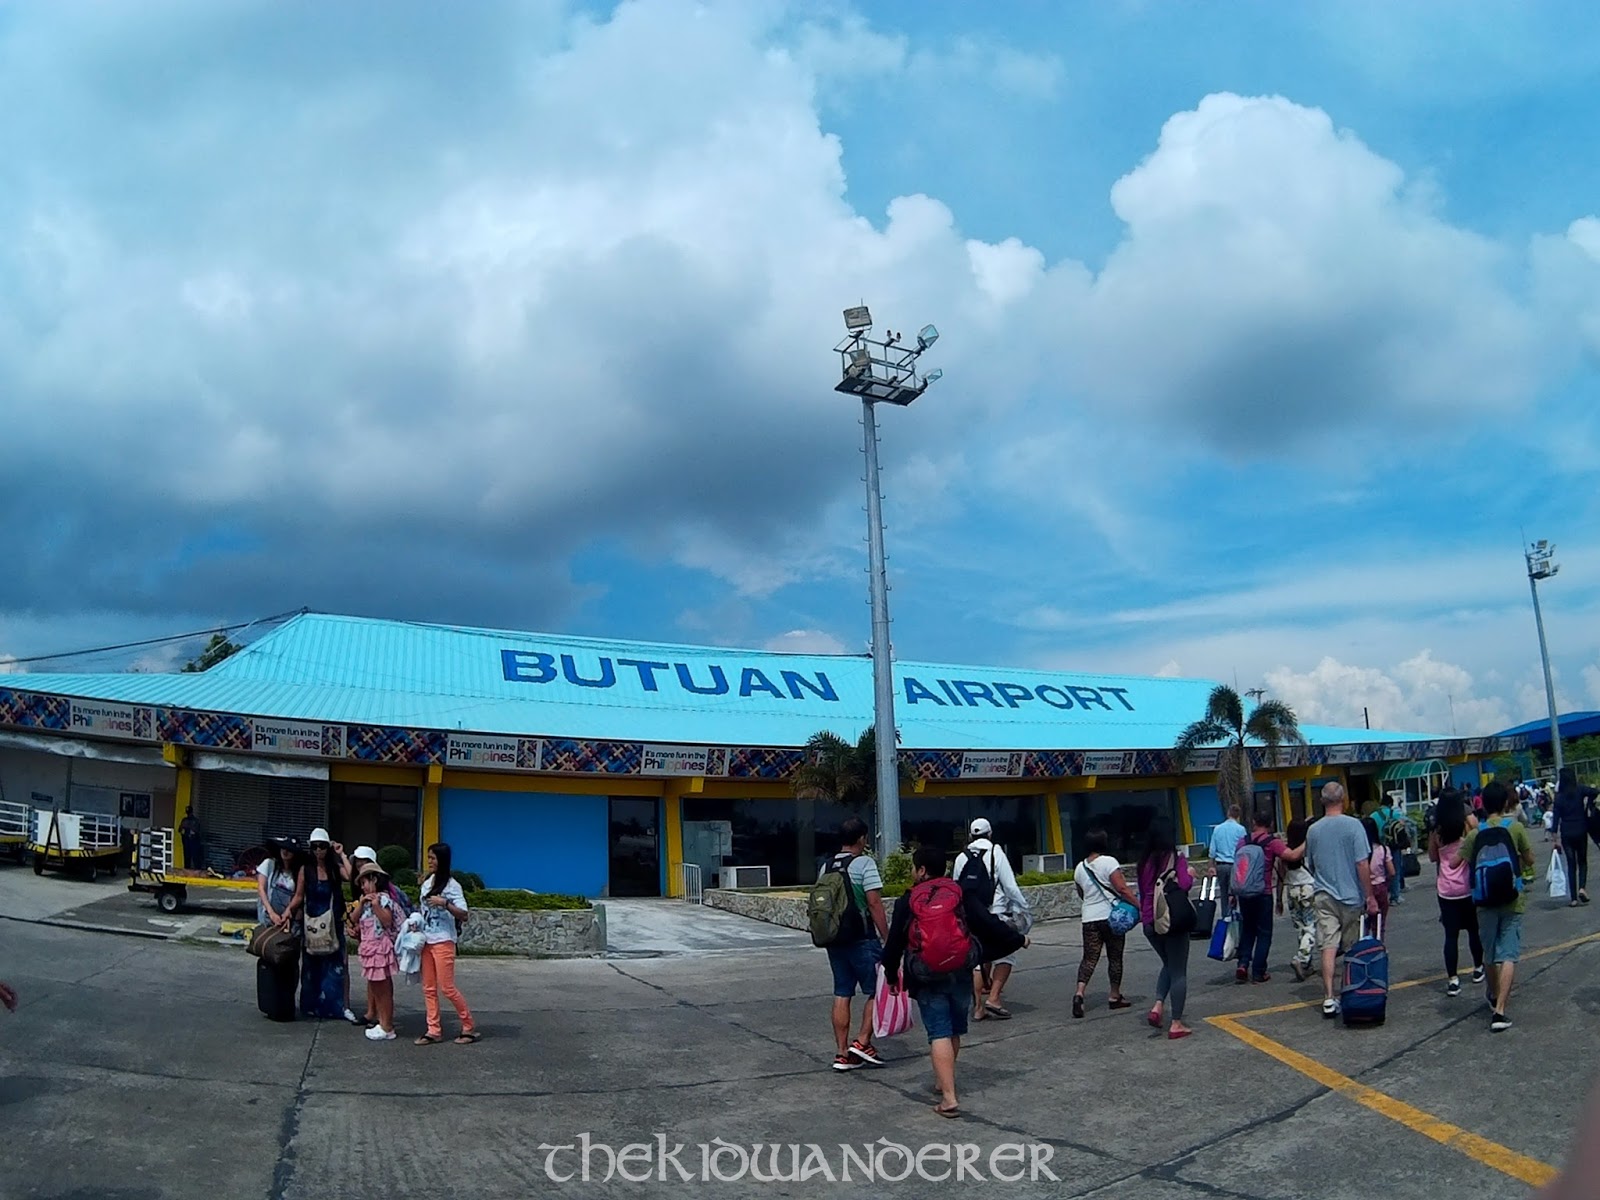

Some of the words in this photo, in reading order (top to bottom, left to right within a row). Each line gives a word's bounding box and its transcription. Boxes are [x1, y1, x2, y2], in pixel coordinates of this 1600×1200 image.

[500, 649, 839, 702] BUTUAN
[904, 676, 1136, 712] AIRPORT
[72, 714, 132, 732] Philpines
[255, 733, 320, 750] Philppines
[450, 748, 515, 763] Philppines
[644, 758, 705, 772] Philppines
